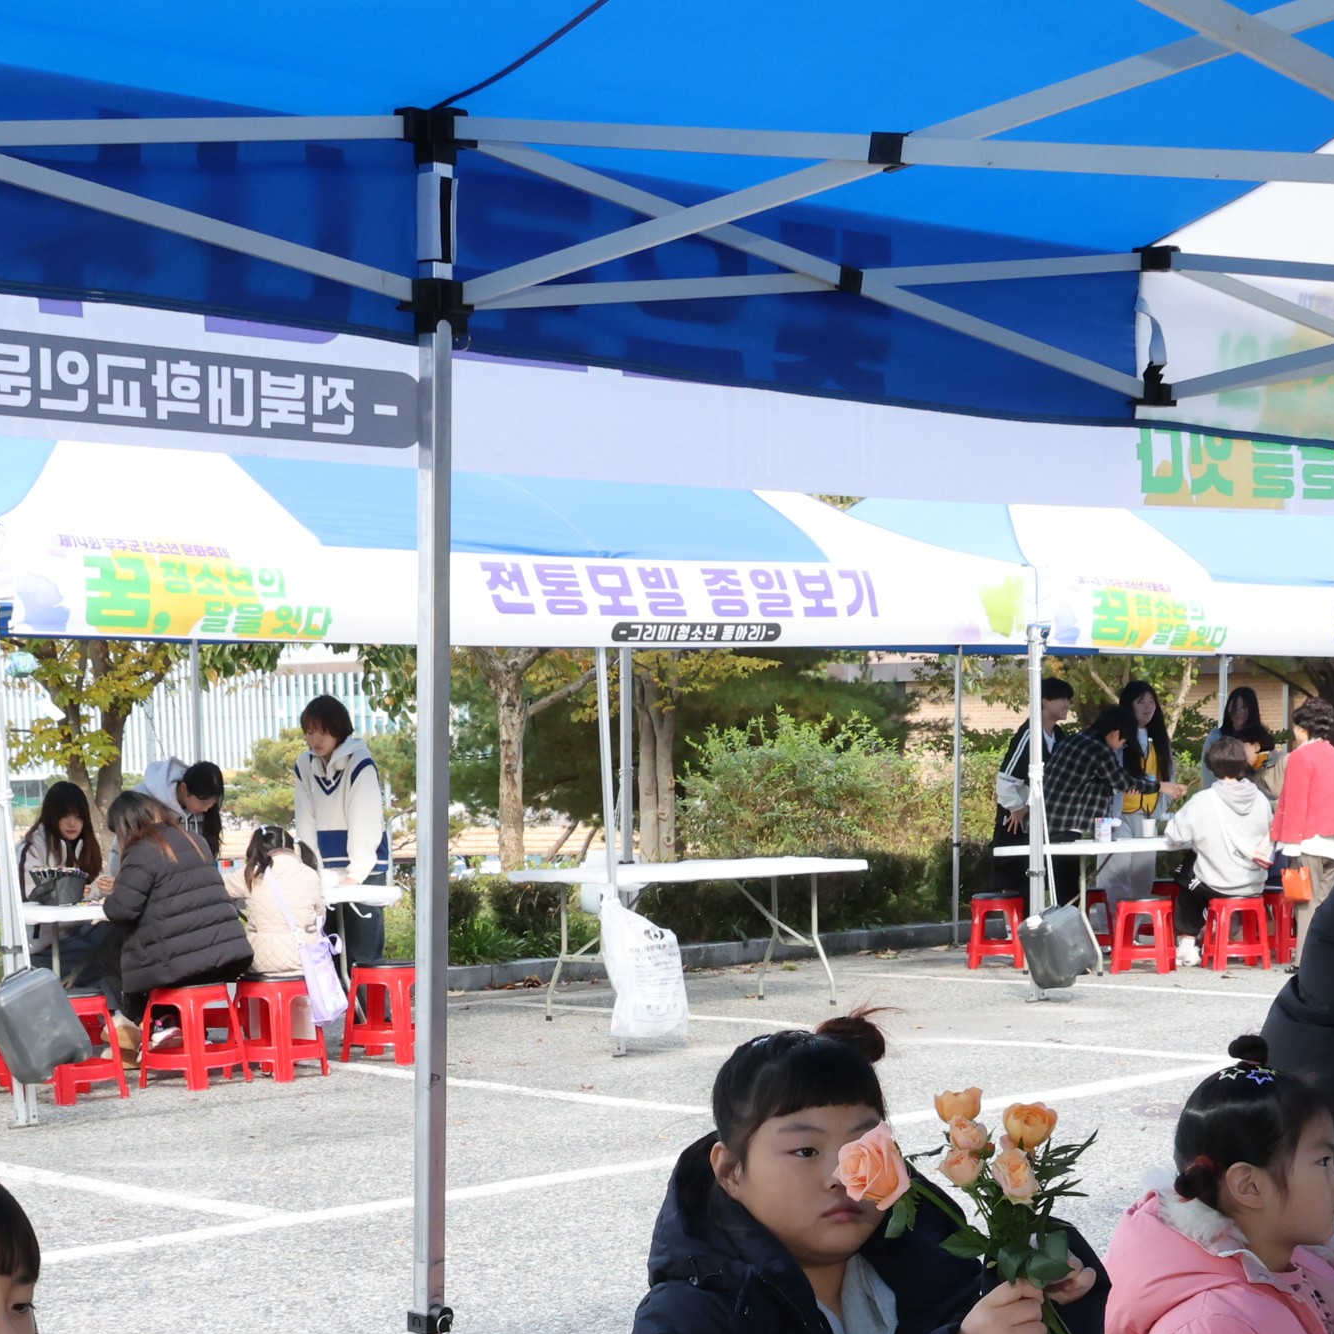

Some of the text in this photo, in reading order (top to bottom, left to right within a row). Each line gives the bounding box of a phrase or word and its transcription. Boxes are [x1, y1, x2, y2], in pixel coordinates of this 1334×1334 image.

[87, 558, 285, 634] 꿈, 청소년의
[485, 564, 878, 617] 전통모빌 종일보기
[203, 603, 332, 637] 달을 잇다
